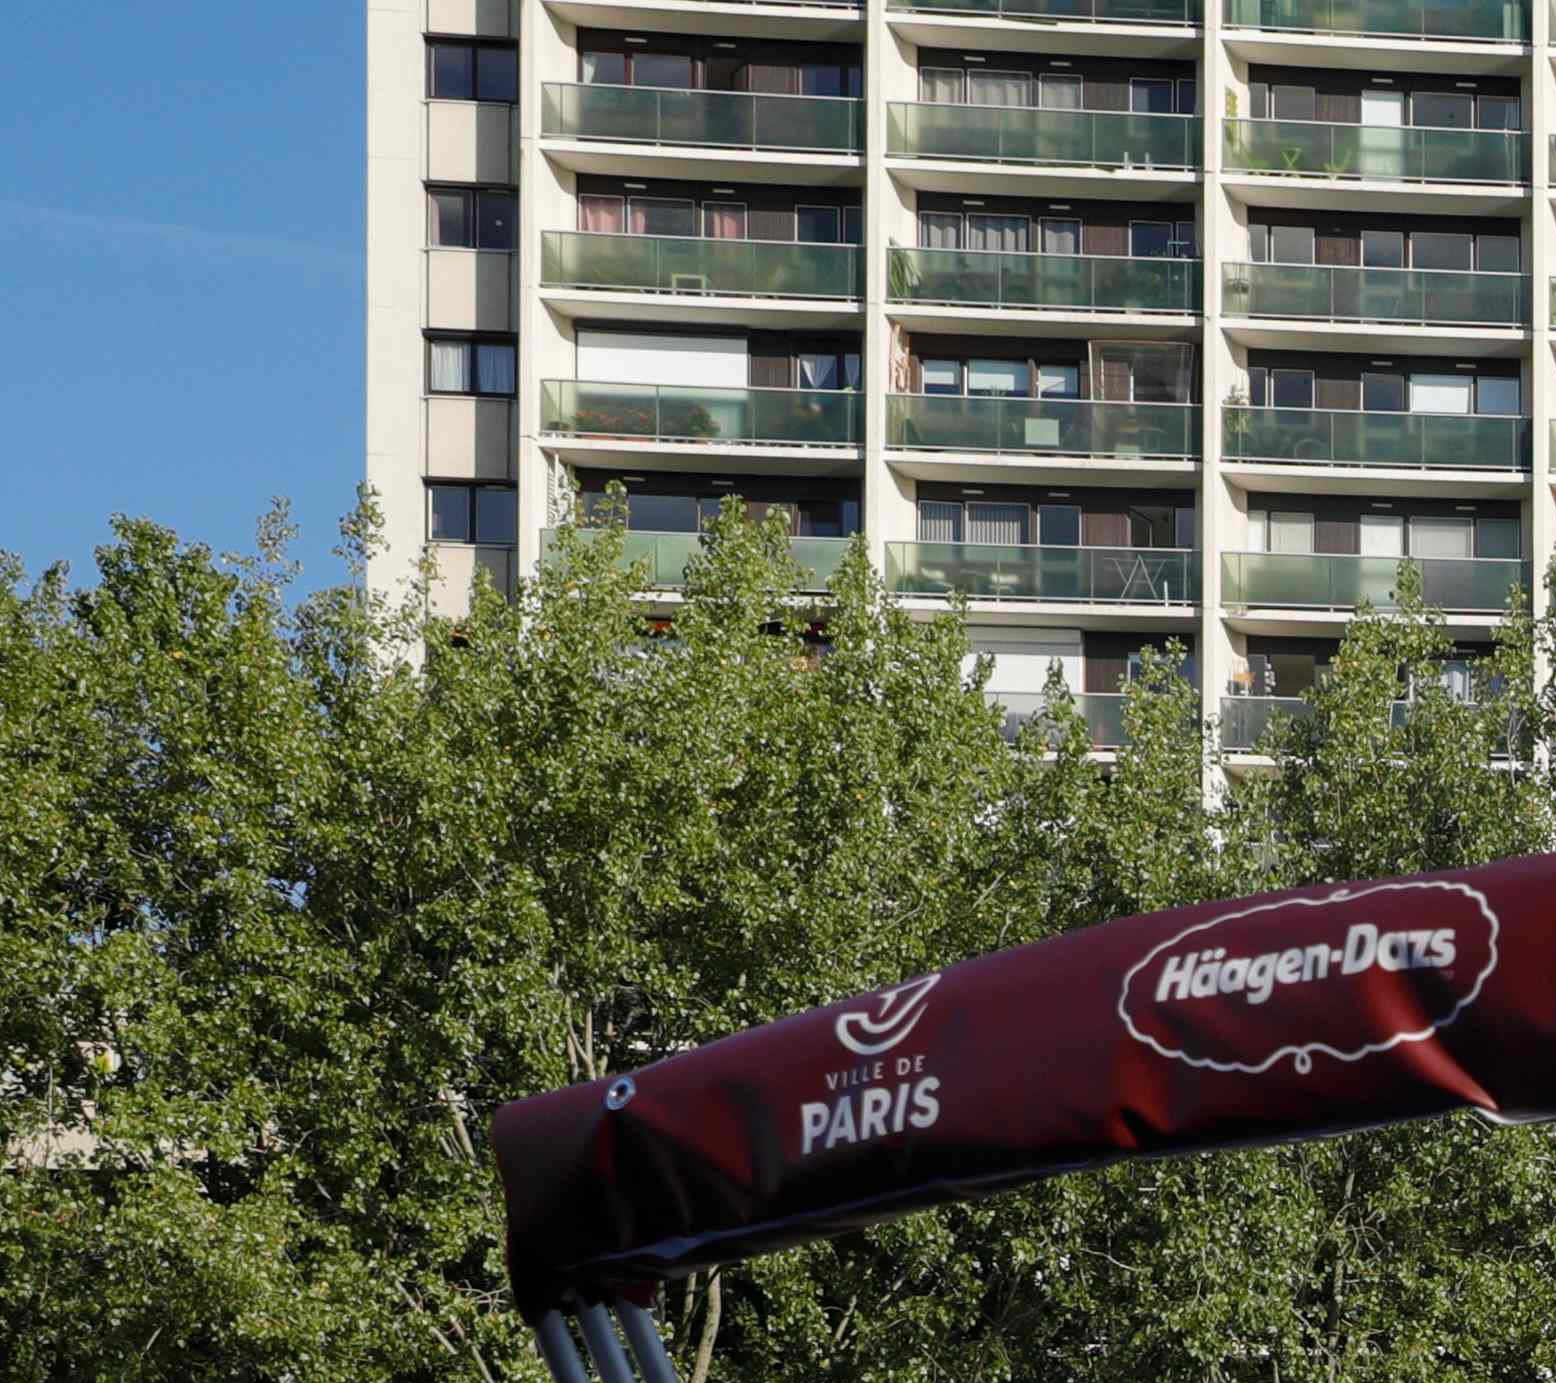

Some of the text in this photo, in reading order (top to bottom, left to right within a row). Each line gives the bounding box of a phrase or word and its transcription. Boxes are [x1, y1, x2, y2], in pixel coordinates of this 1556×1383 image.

[1155, 921, 1458, 1005] Häagen-Dazs
[825, 1054, 926, 1090] VILLE DE
[801, 1076, 940, 1154] PARIS
